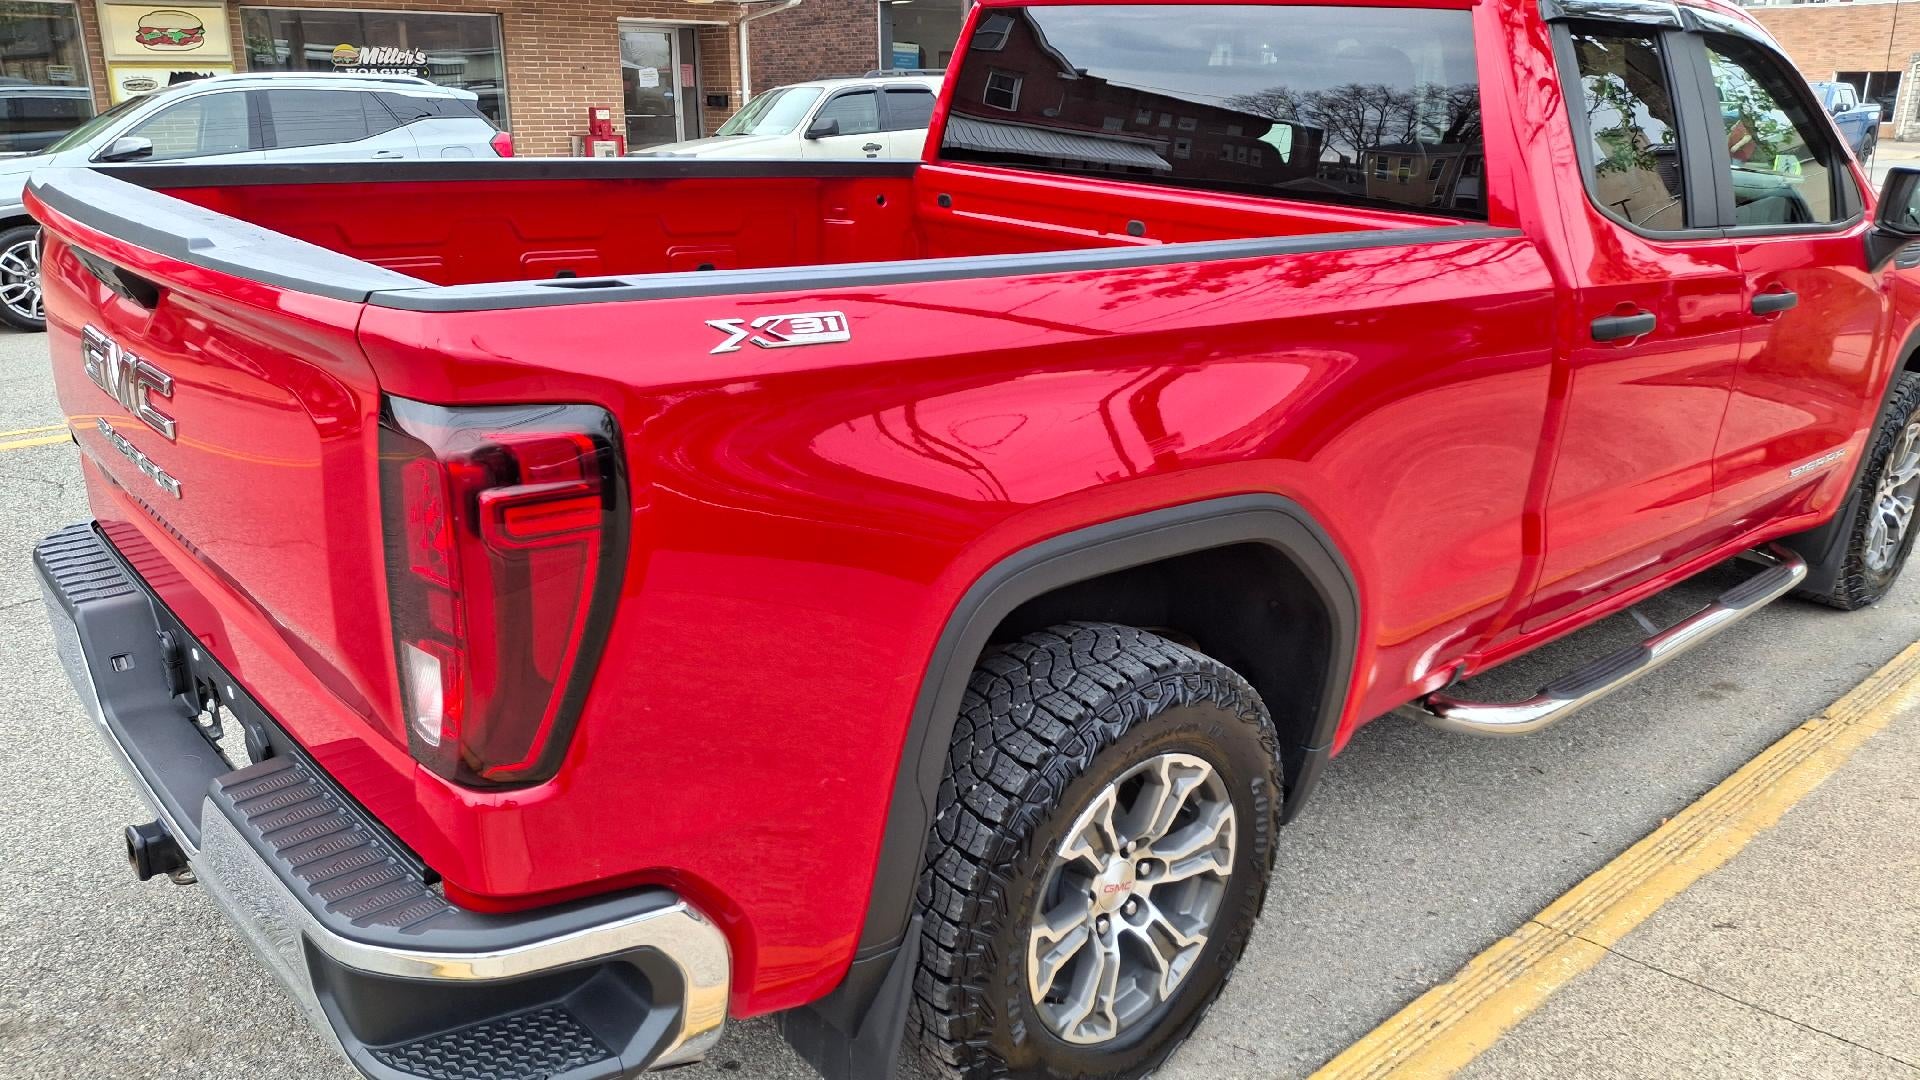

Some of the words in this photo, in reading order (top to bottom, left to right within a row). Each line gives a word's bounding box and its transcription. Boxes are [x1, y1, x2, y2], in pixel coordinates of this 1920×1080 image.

[360, 47, 427, 65] Miller's
[345, 68, 418, 76] HOAGIES
[704, 311, 850, 354] X31
[81, 322, 177, 441] GMC
[96, 416, 182, 499] SIERRA
[1103, 881, 1132, 893] GMC
